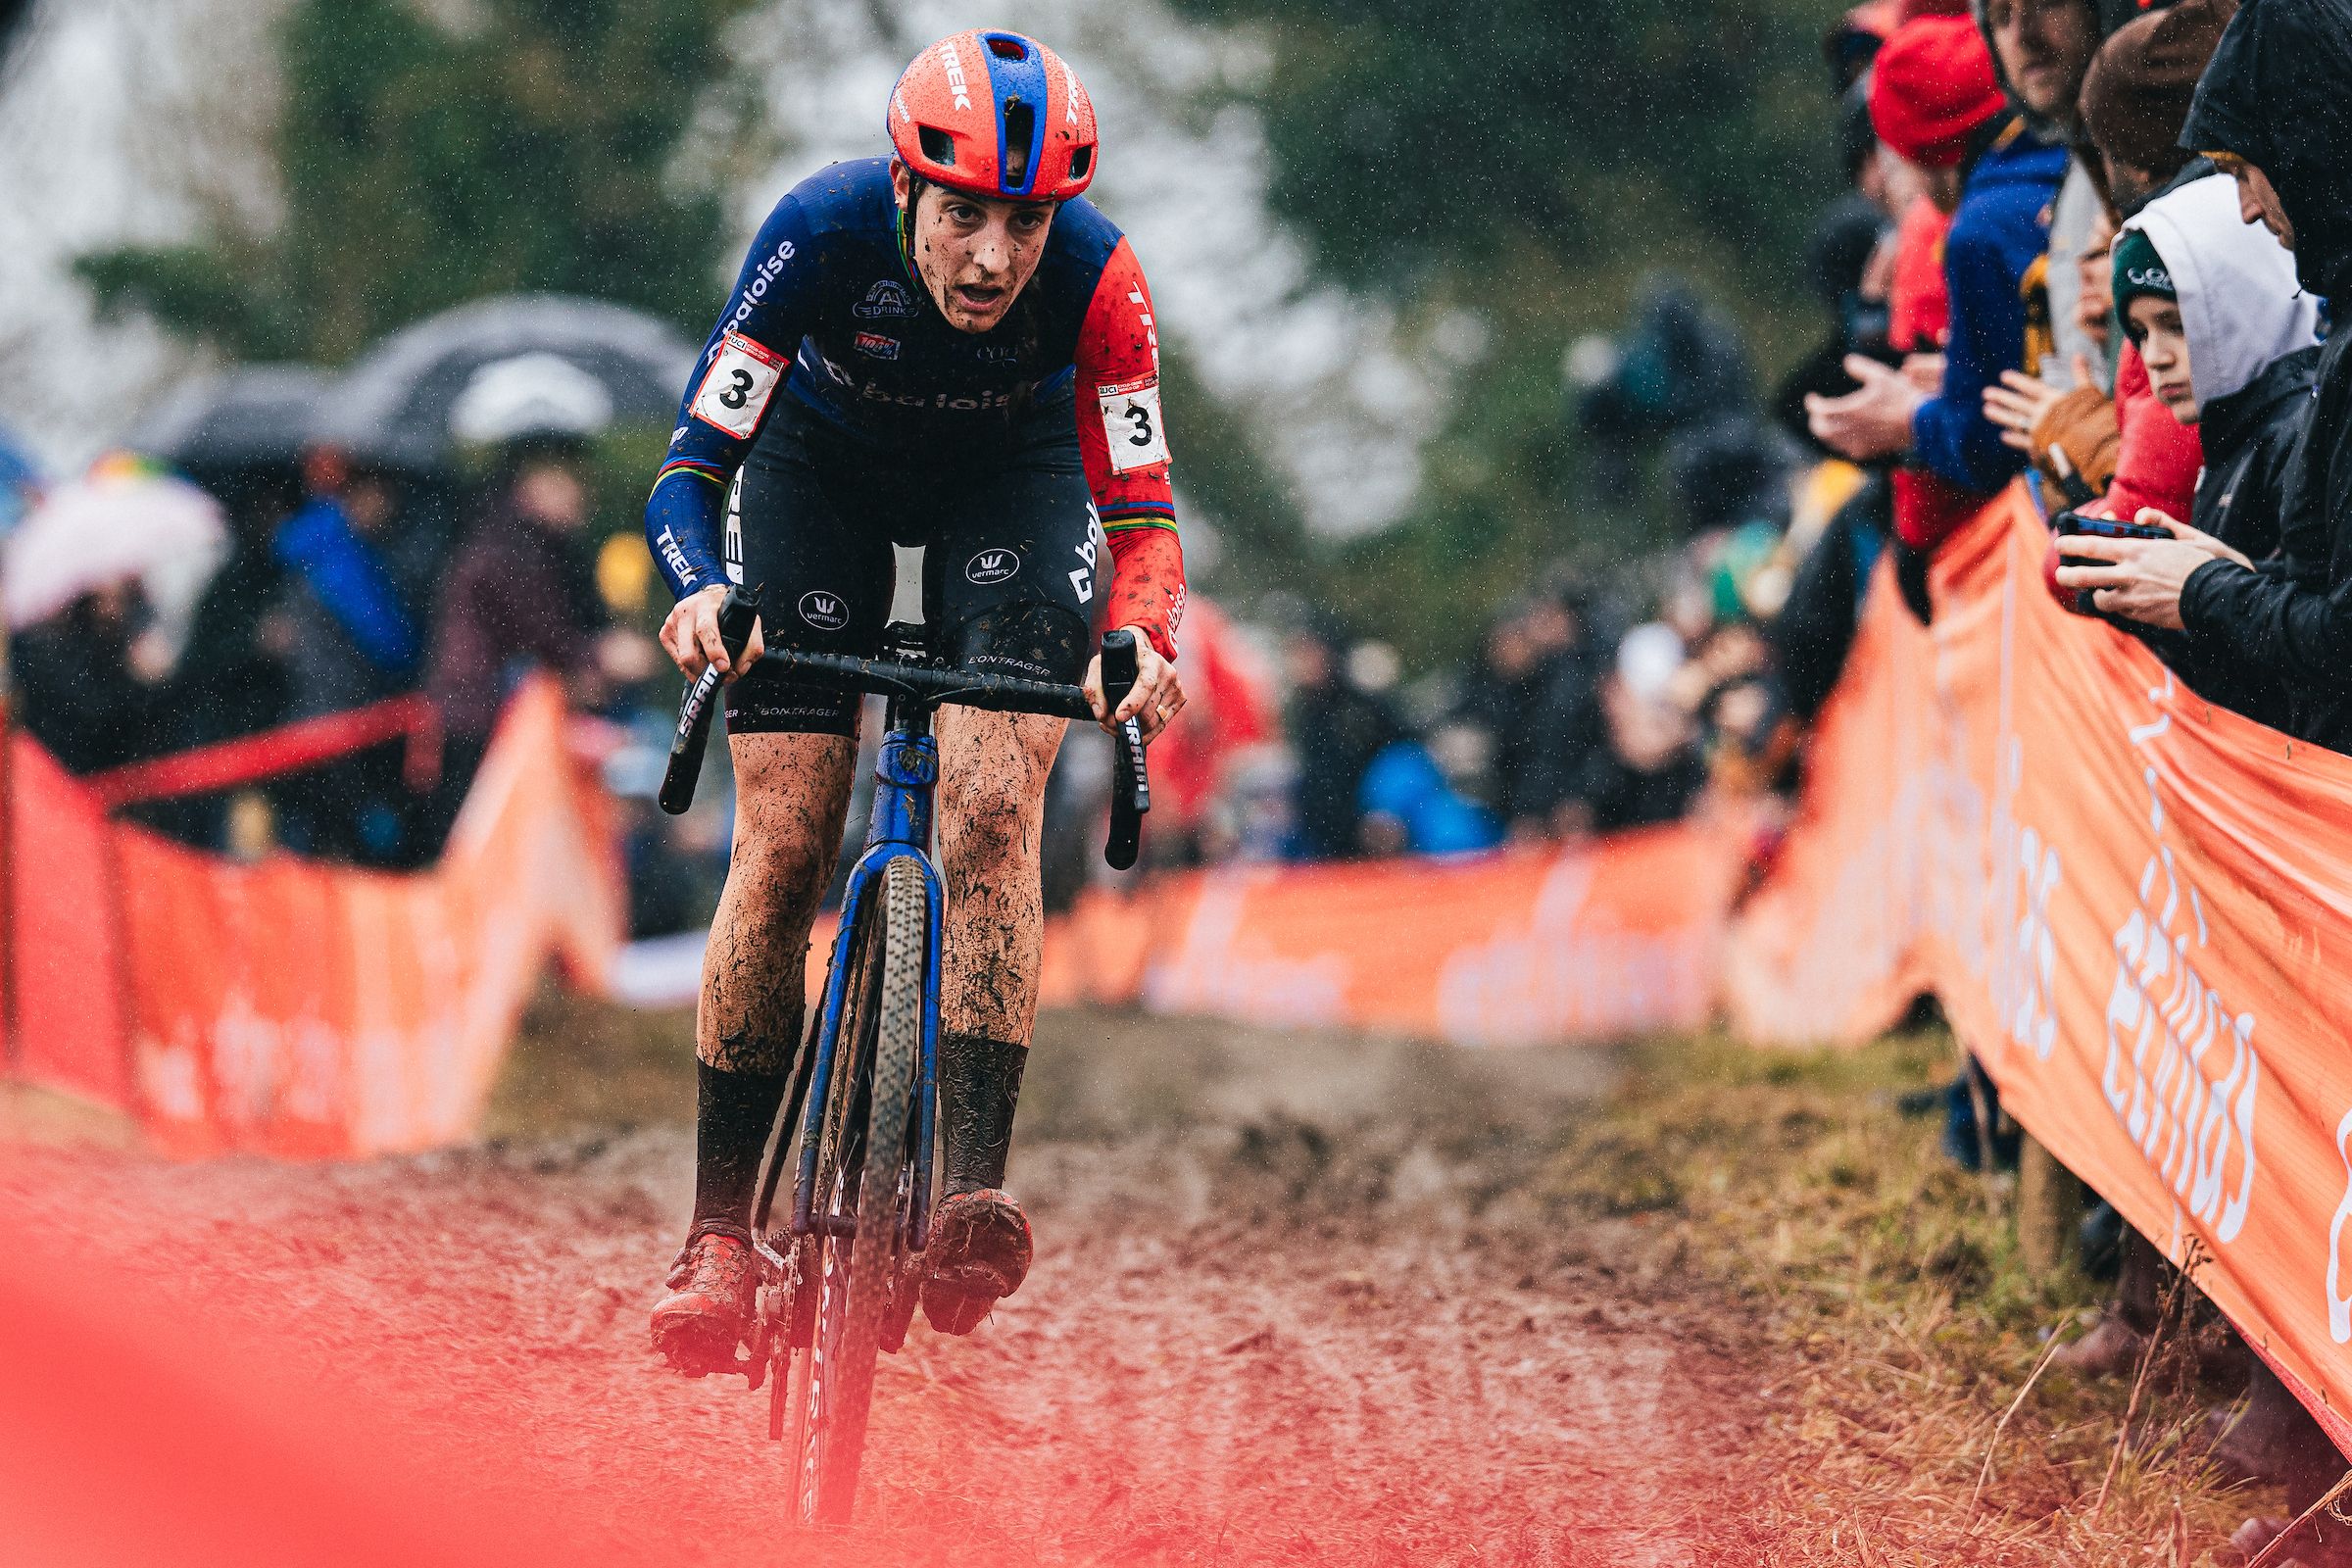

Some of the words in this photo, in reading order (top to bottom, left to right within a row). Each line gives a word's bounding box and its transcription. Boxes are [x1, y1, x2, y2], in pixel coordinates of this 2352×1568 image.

[722, 240, 796, 334] baloise
[873, 306, 906, 316] DRINK
[730, 336, 746, 349] UCI
[719, 368, 754, 410] 3
[1124, 406, 1152, 447] 3
[656, 523, 698, 588] TREK
[971, 567, 1010, 580] vermarc
[807, 612, 843, 625] vermarc
[760, 707, 841, 718] BONTRAGER
